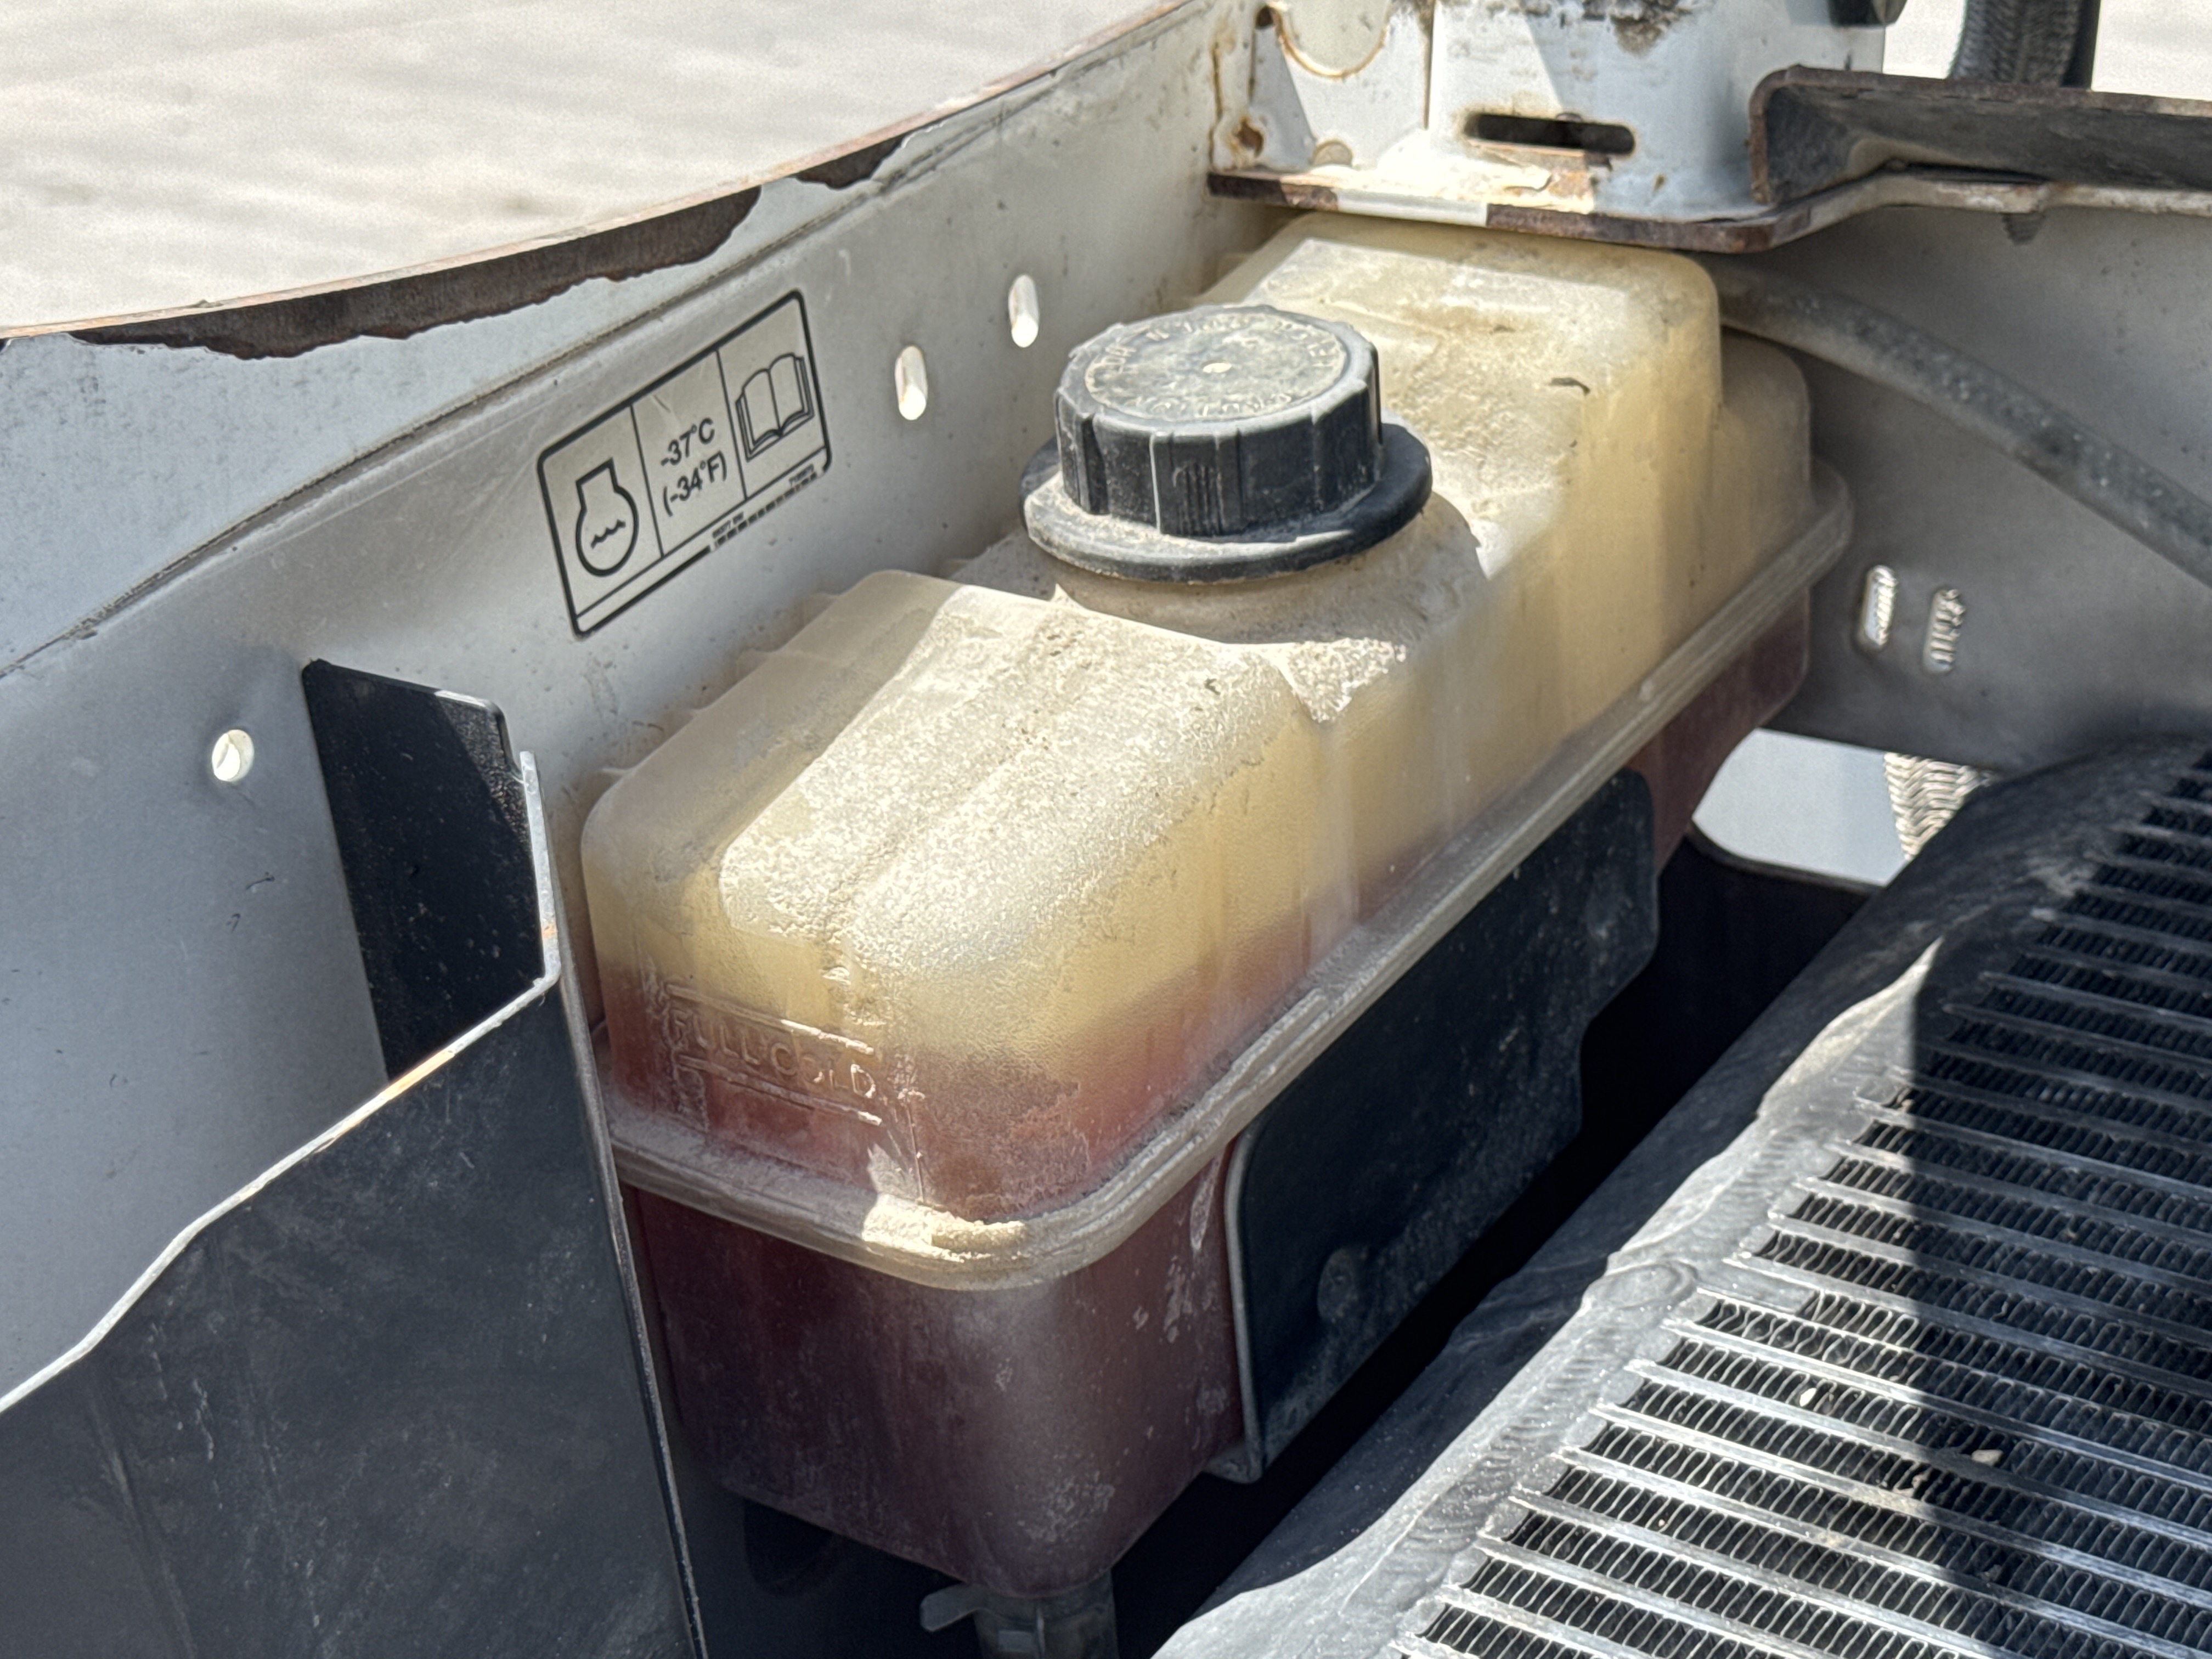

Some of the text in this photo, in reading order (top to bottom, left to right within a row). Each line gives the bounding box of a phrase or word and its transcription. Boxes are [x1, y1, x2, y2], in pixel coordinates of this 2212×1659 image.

[661, 417, 715, 466] -37°C
[663, 449, 727, 517] (-34°F)
[669, 1008, 877, 1098] FULL COLD
